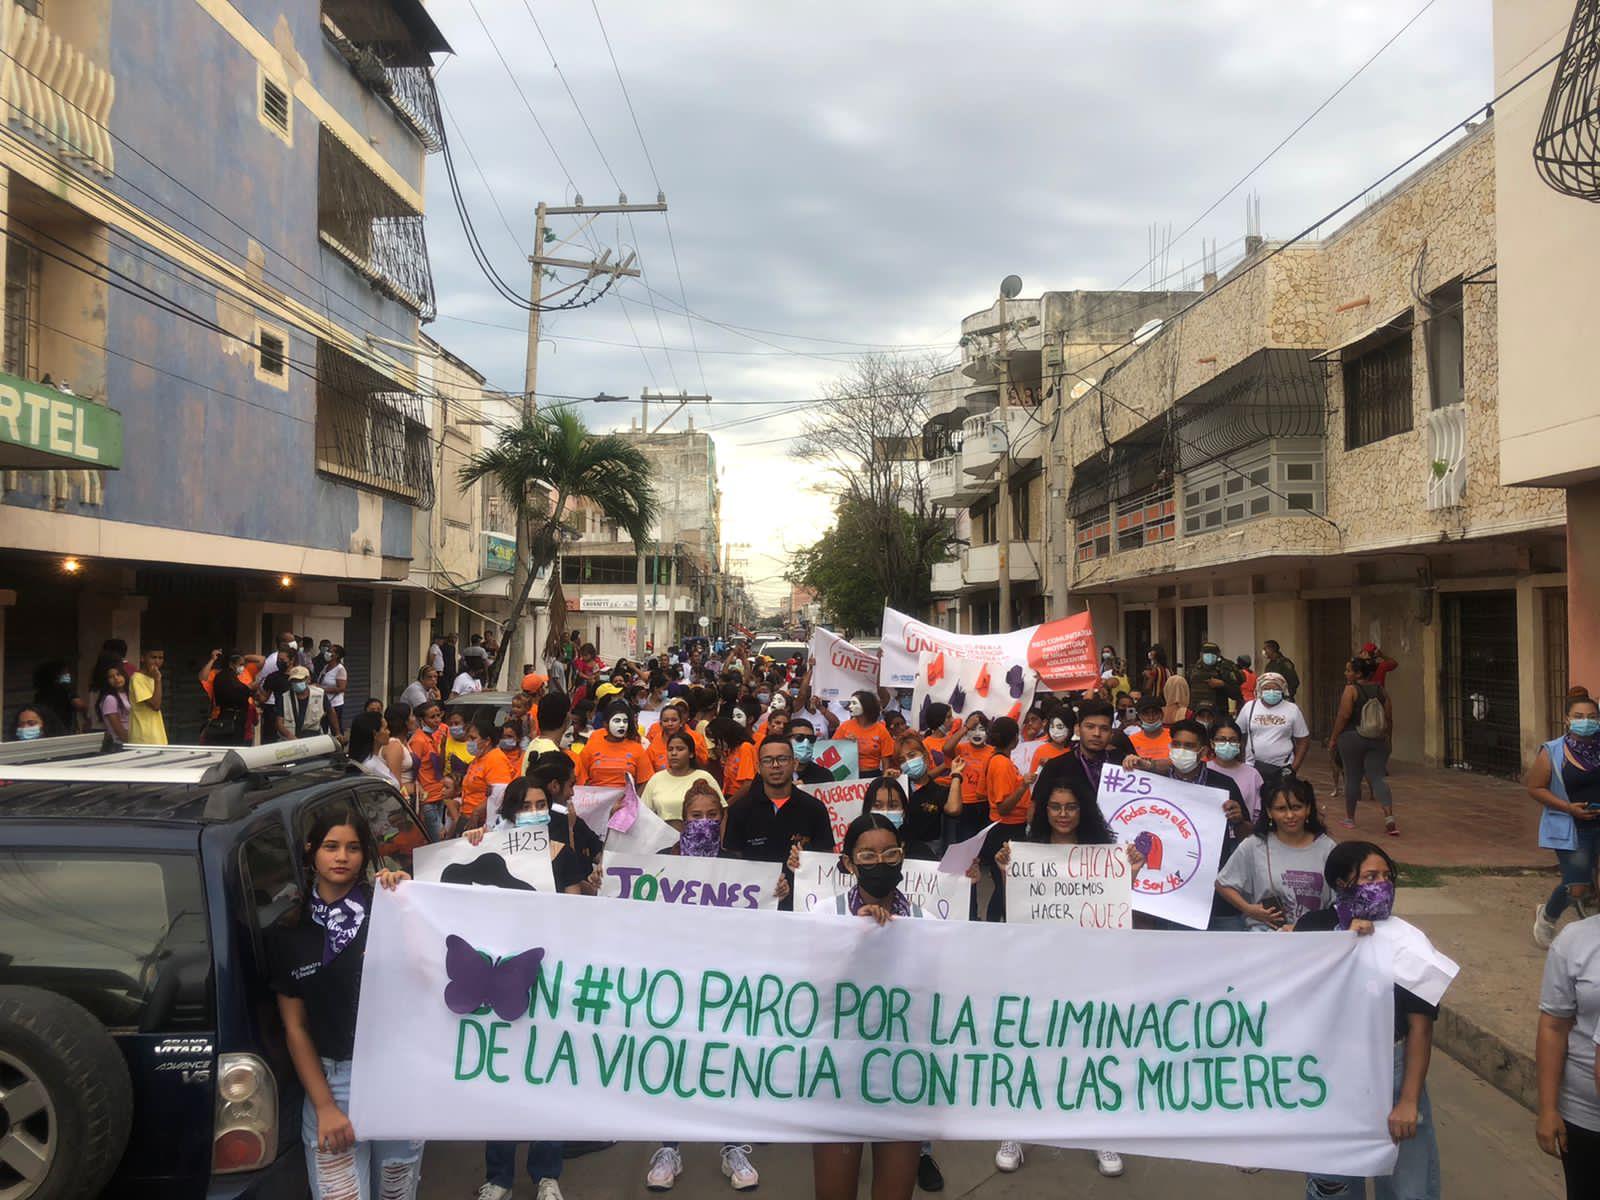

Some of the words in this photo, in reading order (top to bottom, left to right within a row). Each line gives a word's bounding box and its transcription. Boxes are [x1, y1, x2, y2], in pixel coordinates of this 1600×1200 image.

[1103, 768, 1152, 795] #25
[502, 831, 547, 855] #25
[1068, 846, 1126, 880] CHICAS
[1030, 882, 1046, 897] NO
[1055, 881, 1104, 897] PODEMOS
[1031, 903, 1074, 919] HACER
[572, 964, 684, 1030] #YO
[698, 970, 820, 1039] PARO
[834, 981, 911, 1043] POR
[930, 992, 977, 1047] LA
[993, 985, 1267, 1052] ELIMINACIÓN
[154, 1060, 212, 1071] ADVANCE
[182, 1070, 210, 1083] V6
[454, 1018, 512, 1083] DE
[524, 1024, 579, 1086] LA
[593, 1031, 841, 1100] VIOLENCIA
[861, 1047, 1043, 1110] CONTRA
[1056, 1055, 1123, 1111] LAS
[1139, 1054, 1328, 1111] MUJERES
